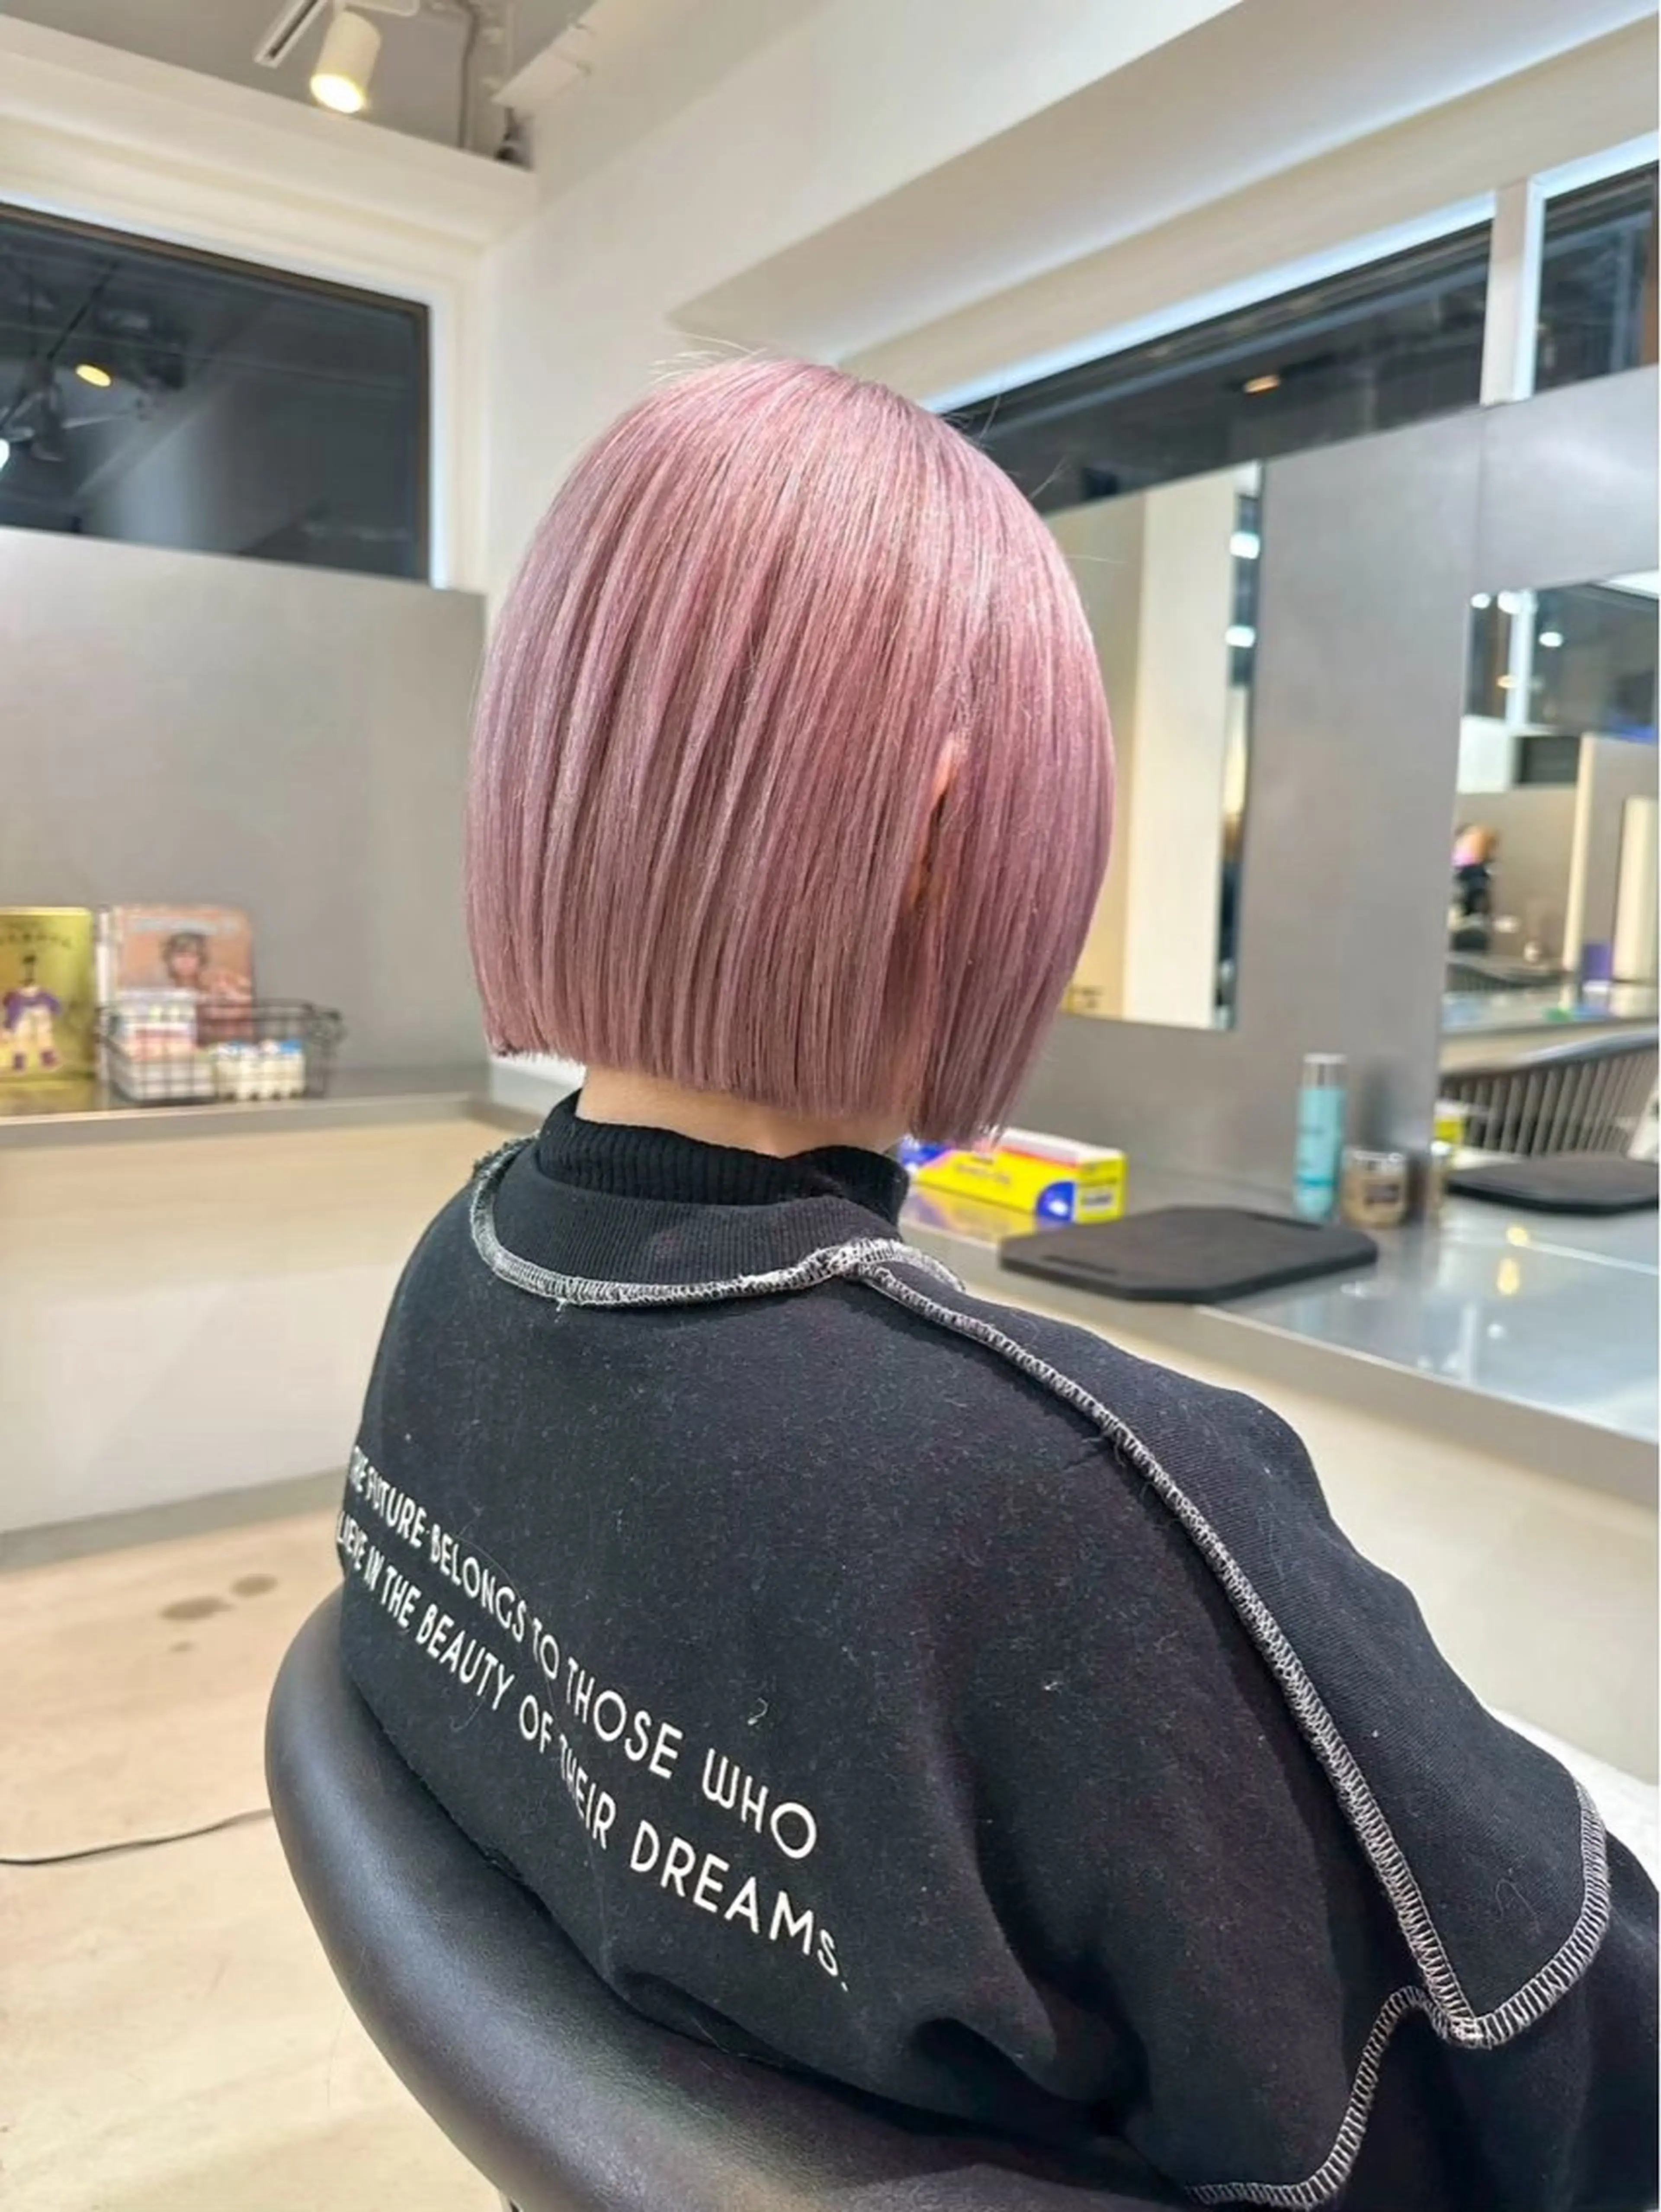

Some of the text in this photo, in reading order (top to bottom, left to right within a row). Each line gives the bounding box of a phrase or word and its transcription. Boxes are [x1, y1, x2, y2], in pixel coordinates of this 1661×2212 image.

[363, 1545, 385, 1592] IN
[381, 1565, 422, 1629] THE
[415, 1603, 515, 1711] BEAUTY
[519, 1694, 554, 1754] OF
[559, 1733, 616, 1850] THEIR
[630, 1819, 848, 1992] DREAMS.
[365, 1465, 427, 1548] FUTURE
[430, 1523, 527, 1643] BELONGS
[532, 1617, 560, 1680] TO
[566, 1657, 683, 1779] THOSE
[702, 1747, 817, 1859] WHO
